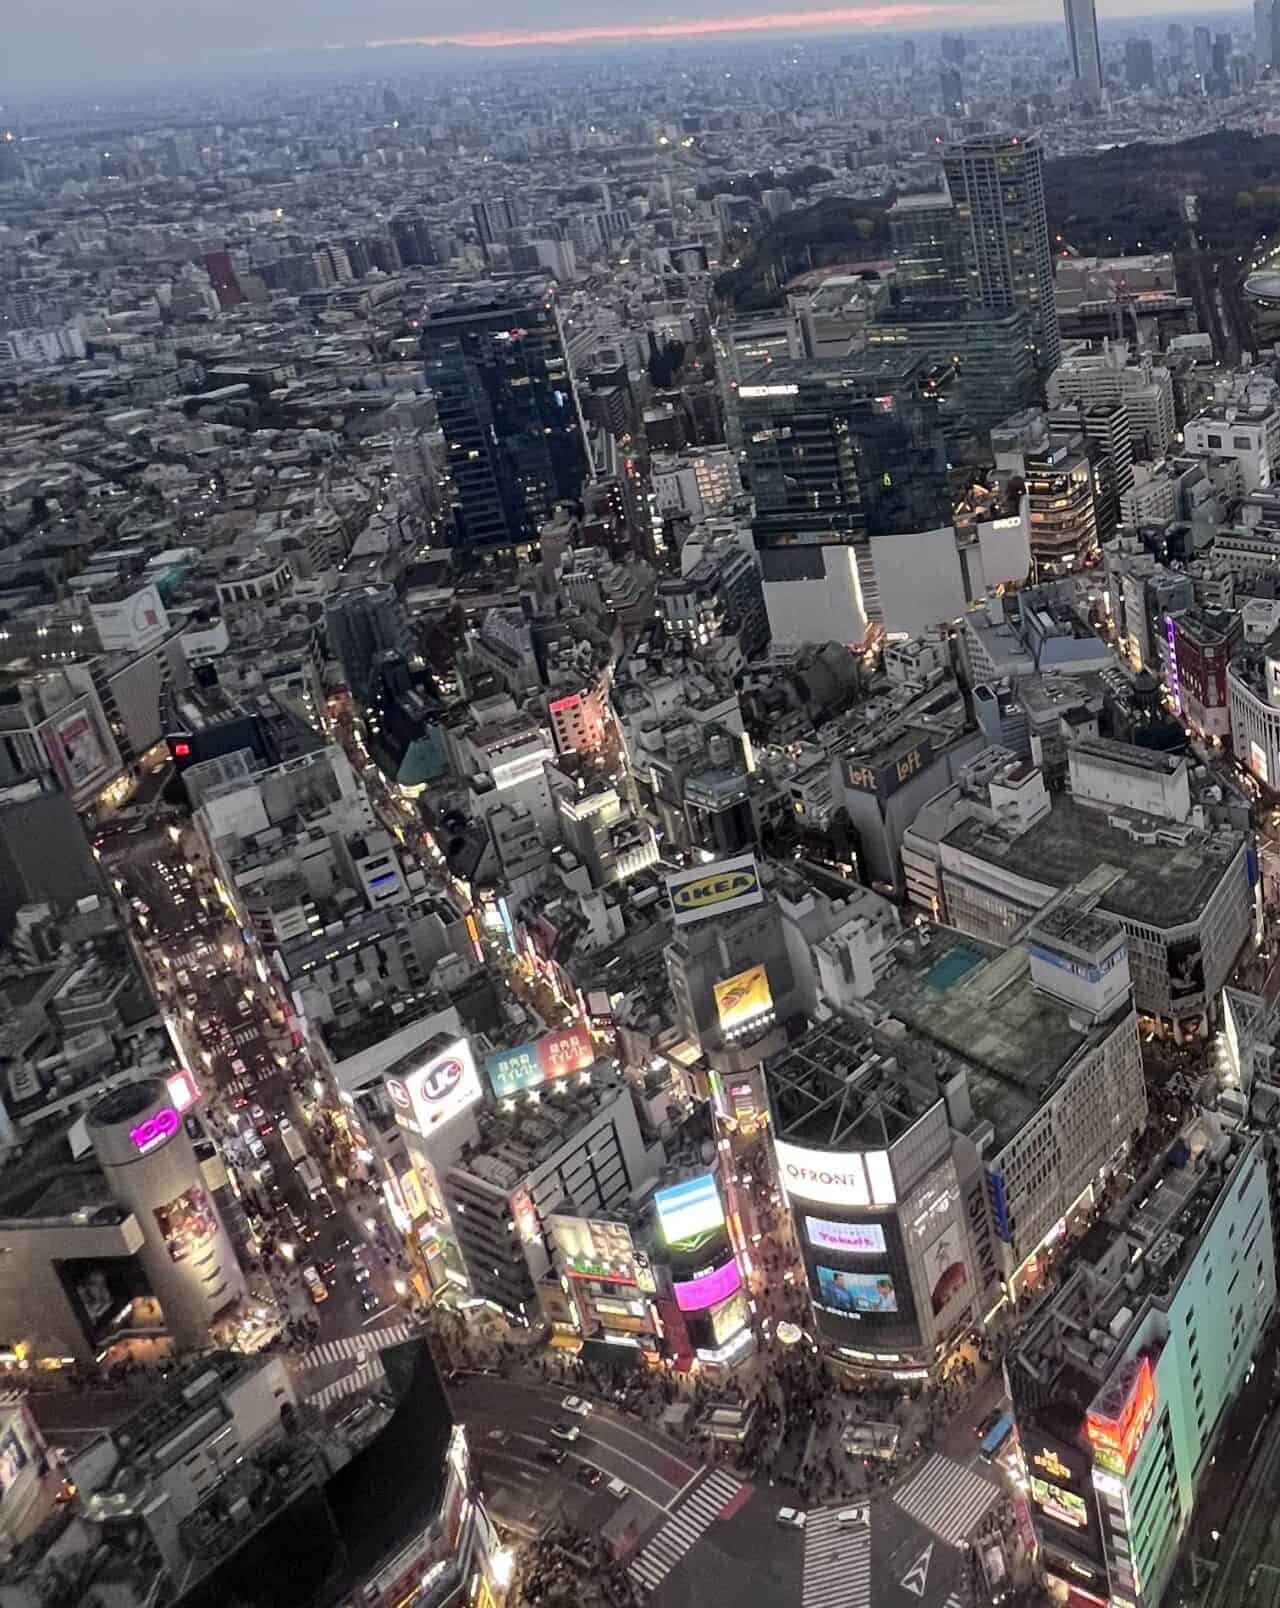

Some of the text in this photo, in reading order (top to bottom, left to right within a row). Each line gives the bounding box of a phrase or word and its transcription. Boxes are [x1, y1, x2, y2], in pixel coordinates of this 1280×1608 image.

[681, 875, 751, 903] IKEA
[786, 1163, 857, 1187] QFRONT
[819, 1231, 876, 1248] Yakult
